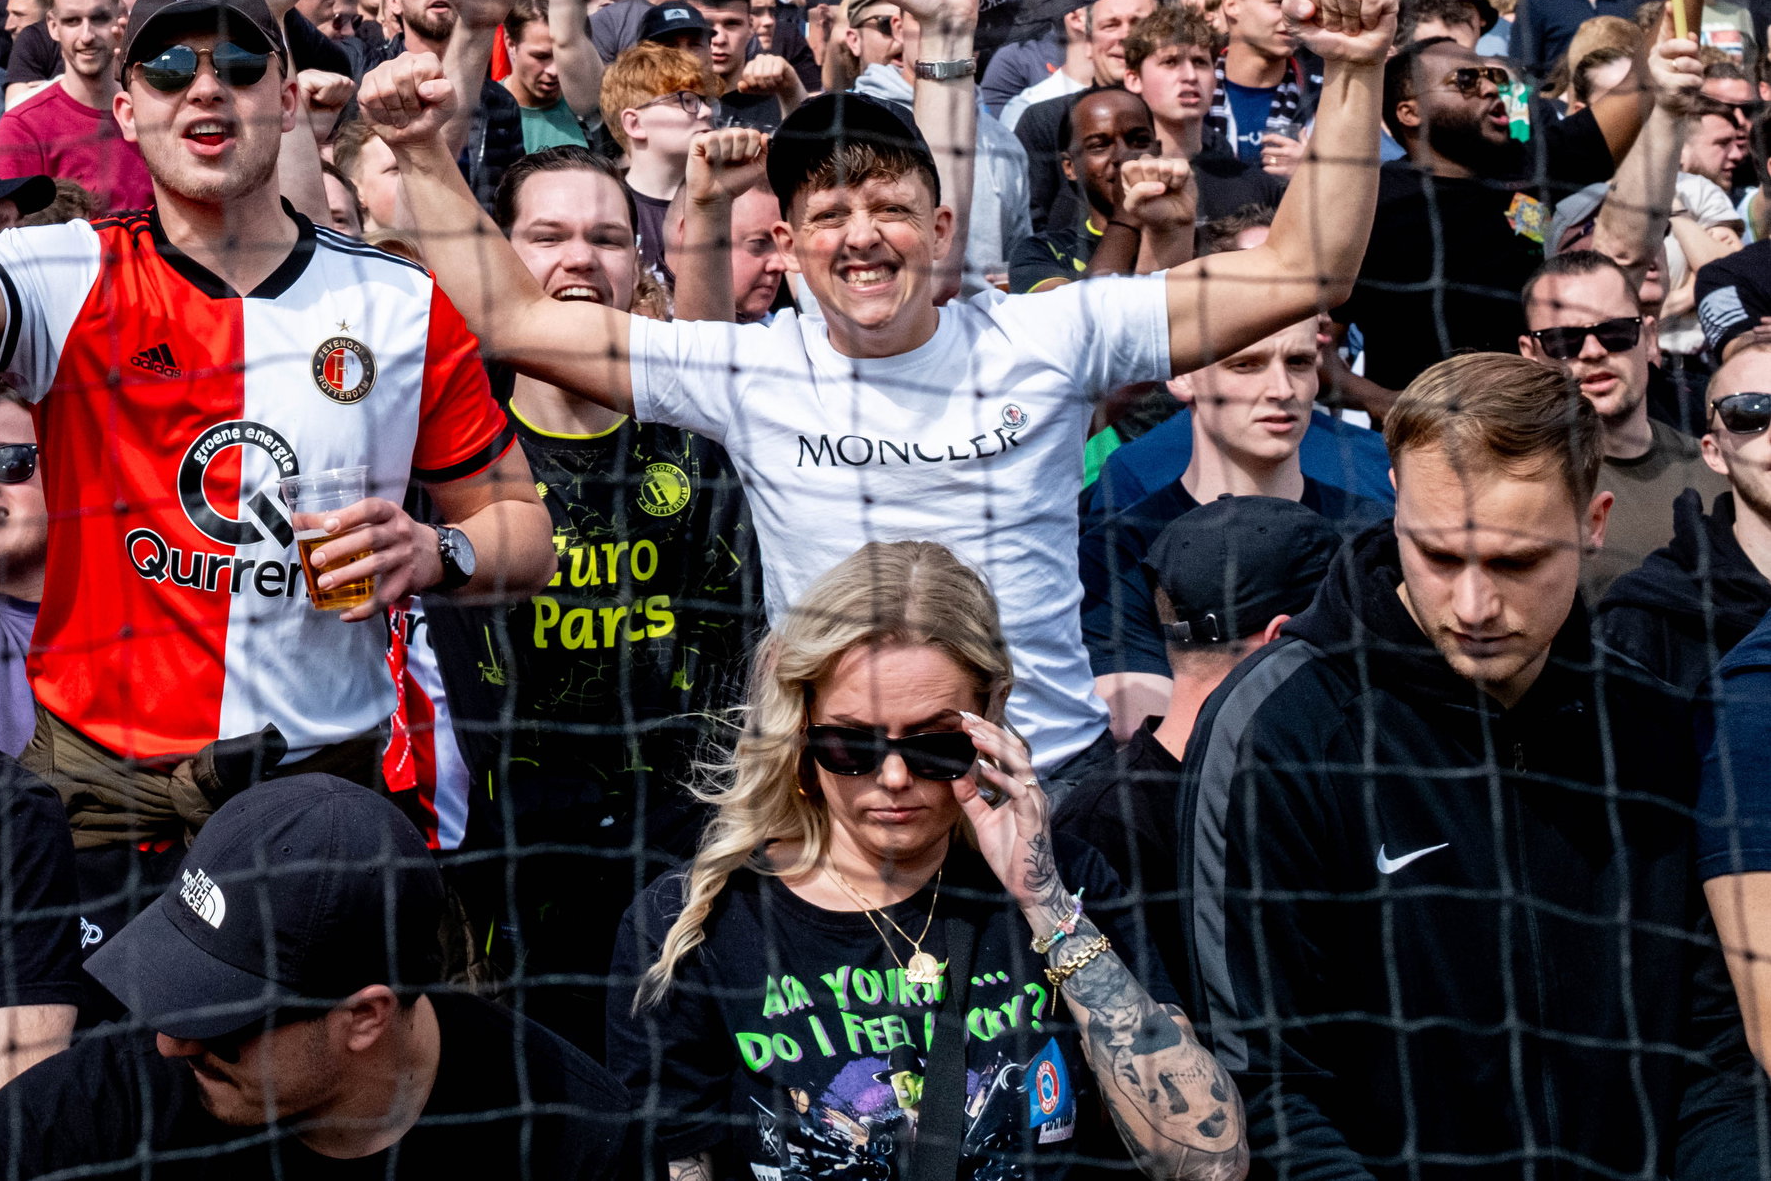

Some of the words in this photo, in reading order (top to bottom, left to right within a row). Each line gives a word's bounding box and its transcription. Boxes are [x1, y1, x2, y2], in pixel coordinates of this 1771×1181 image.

[130, 356, 182, 379] adidas
[317, 339, 370, 364] FEYENOORD
[317, 374, 370, 400] ROTTERDAM
[192, 427, 241, 465] groene
[244, 427, 295, 472] energie
[796, 427, 1022, 468] MONCLER
[125, 528, 312, 599] Qurren
[532, 594, 676, 651] Parcs
[181, 868, 209, 903] NORTH
[194, 867, 214, 891] THE
[179, 885, 203, 913] FACE
[735, 1032, 802, 1072] DO
[808, 1015, 837, 1058] I
